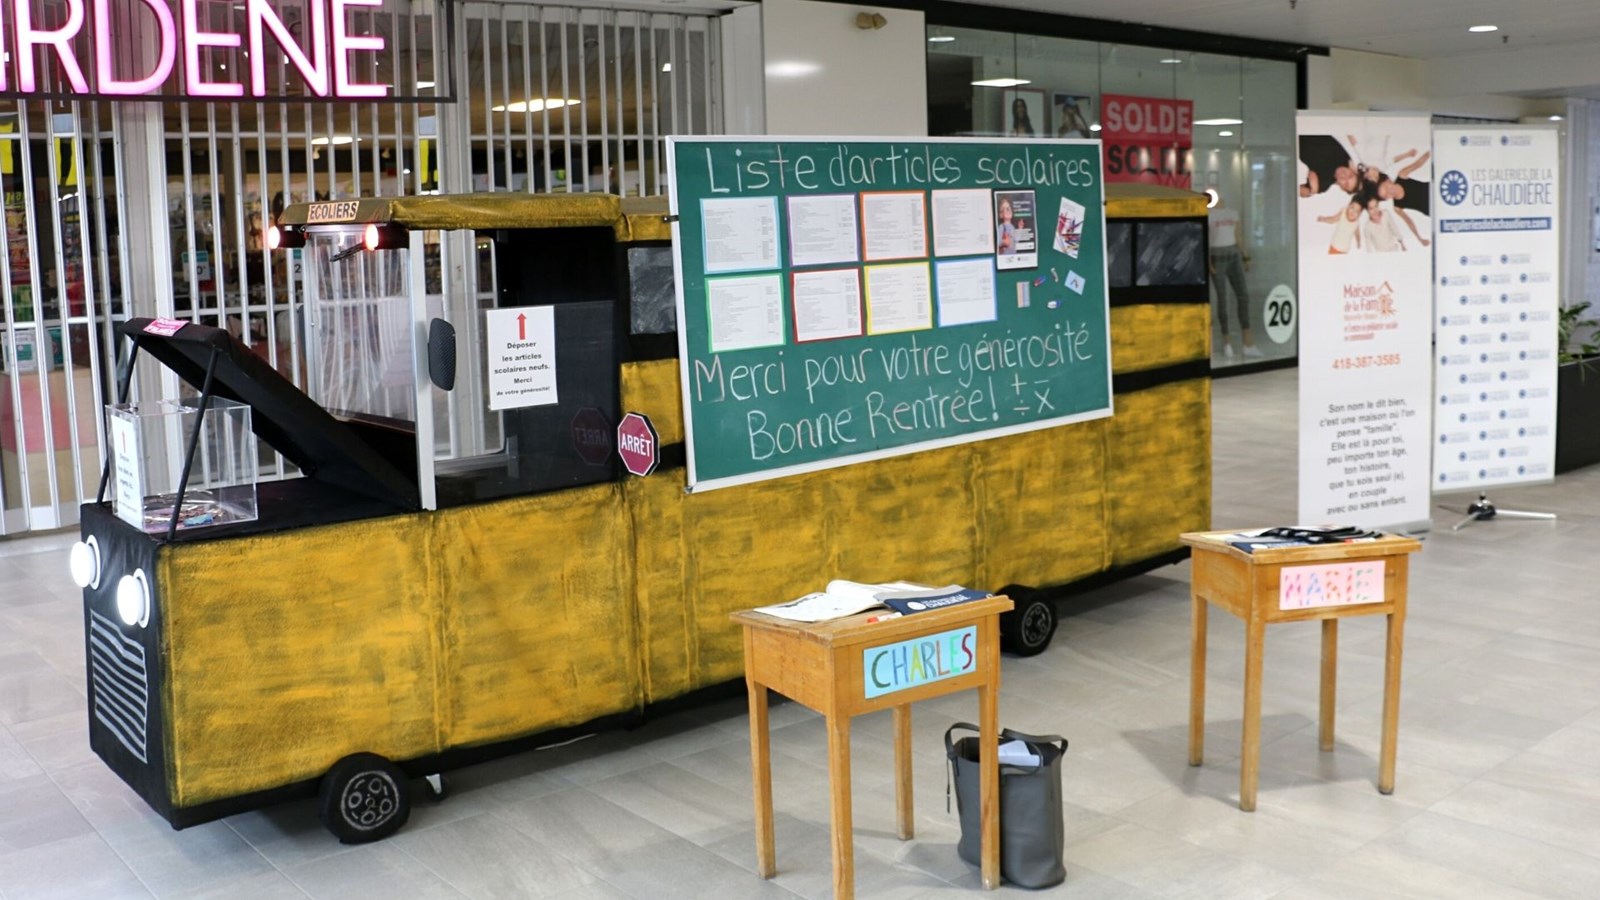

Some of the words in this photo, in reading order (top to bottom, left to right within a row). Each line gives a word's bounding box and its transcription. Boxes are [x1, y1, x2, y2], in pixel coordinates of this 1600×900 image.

[0, 0, 388, 98] RDENE
[1106, 101, 1190, 134] SOLDE
[706, 144, 819, 193] Liste
[829, 144, 961, 187] d'articles
[975, 147, 1094, 187] scolaires
[1471, 169, 1487, 182] LES
[1488, 168, 1528, 181] GALERIES
[1529, 168, 1540, 180] DE
[1541, 168, 1553, 180] LA
[1471, 181, 1553, 206] CHAUDIÈRE
[309, 202, 357, 220] ECOLIERS
[1343, 283, 1377, 298] Maison
[1268, 300, 1293, 328] 20
[507, 342, 537, 350] Déposer
[514, 353, 542, 361] articles
[695, 351, 786, 402] Merci
[804, 348, 873, 404] pour
[880, 334, 952, 383] votre
[958, 320, 1093, 388] générosité
[494, 366, 527, 374] scolaires
[1328, 403, 1346, 413] Son
[1347, 402, 1365, 411] nom
[1367, 400, 1374, 409] le
[1376, 398, 1387, 408] dit
[1341, 416, 1356, 424] une
[1358, 412, 1388, 422] maison
[747, 409, 857, 460] Bonne
[1336, 429, 1361, 439] pense
[621, 432, 652, 458] ARRÊT
[1331, 442, 1346, 452] Elle
[1348, 440, 1361, 449] est
[1372, 437, 1390, 448] pour
[1326, 456, 1343, 466] peu
[1344, 451, 1375, 462] importe
[1376, 449, 1390, 458] ton
[1344, 466, 1358, 475] ton
[1328, 480, 1344, 491] que
[1375, 472, 1392, 482] seul
[1348, 491, 1358, 500] en
[1360, 486, 1387, 498] couple
[1326, 506, 1346, 516] avec
[1348, 504, 1359, 512] ou
[1360, 501, 1379, 510] sans
[1284, 567, 1374, 607] MARIE
[870, 632, 974, 690] CHARLES
